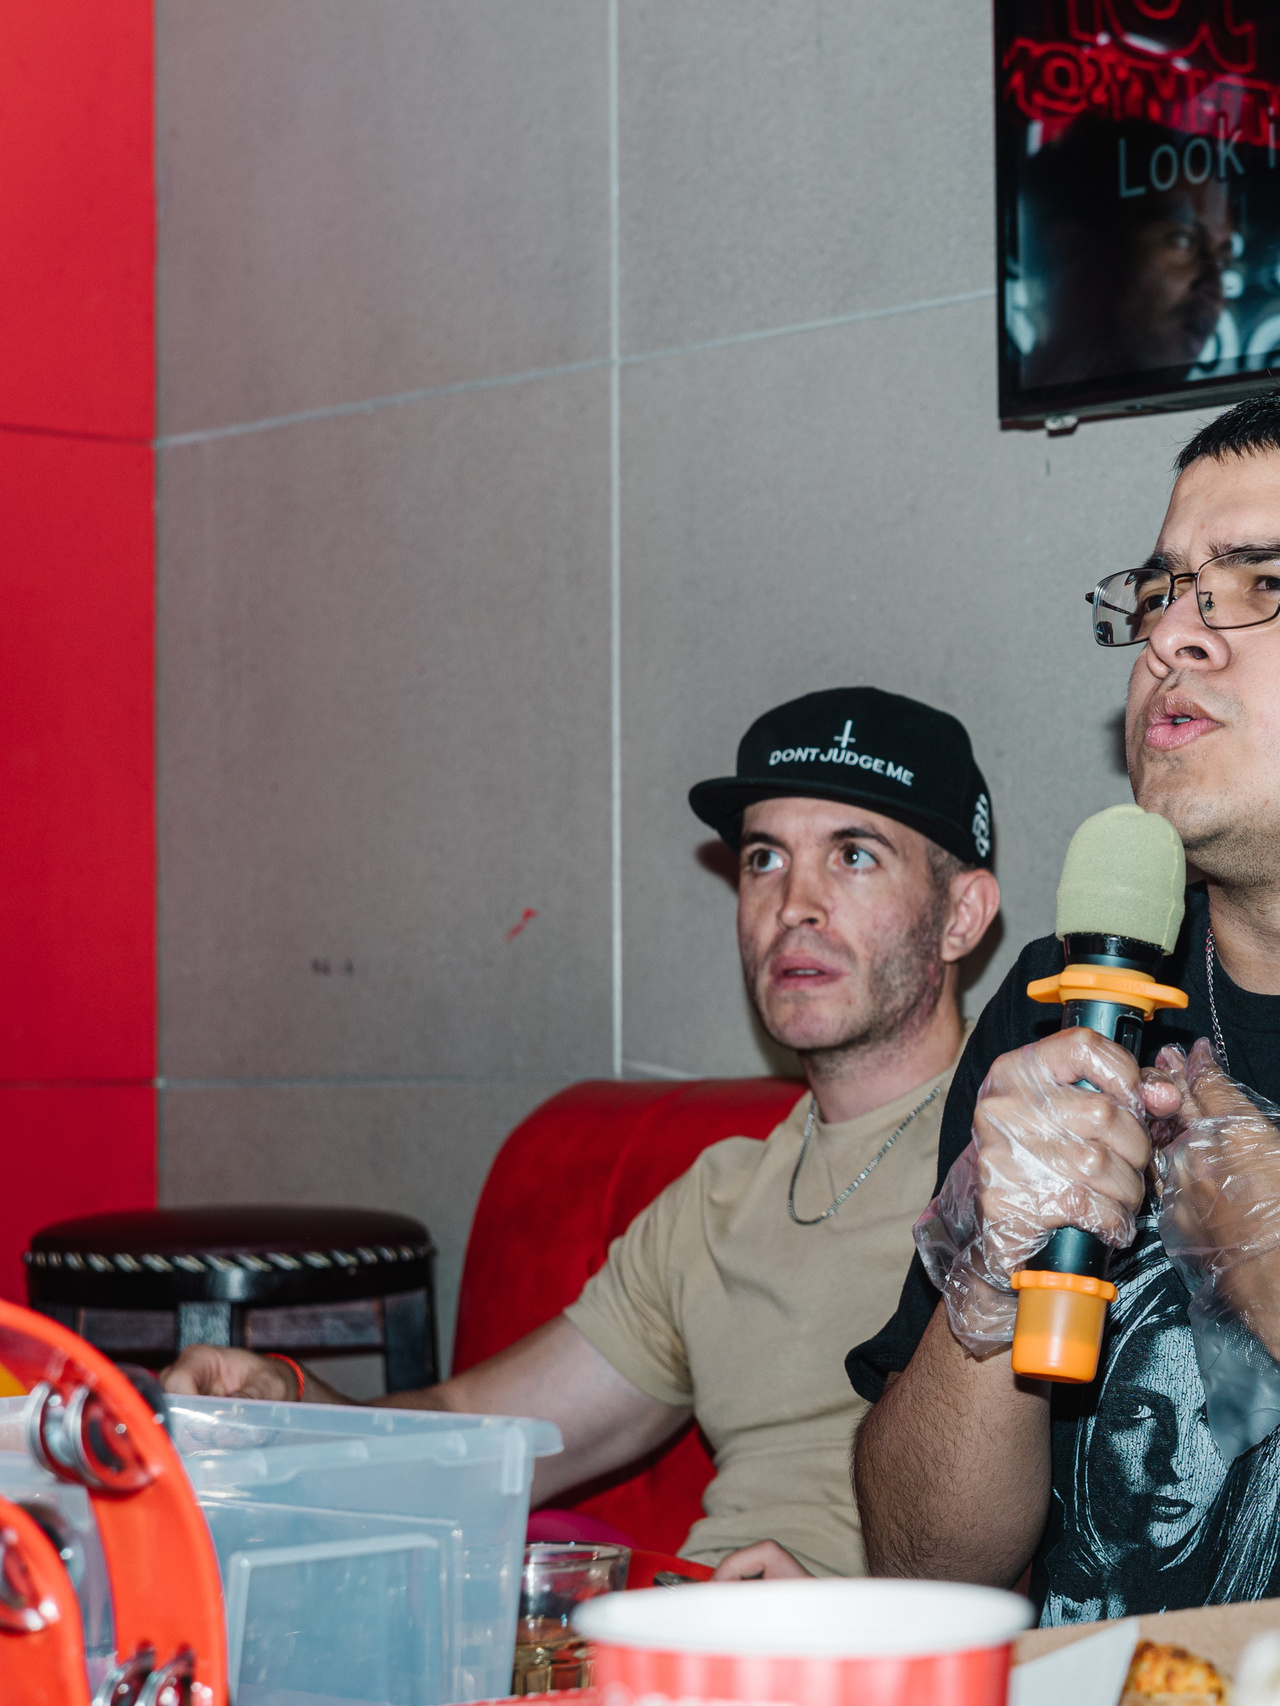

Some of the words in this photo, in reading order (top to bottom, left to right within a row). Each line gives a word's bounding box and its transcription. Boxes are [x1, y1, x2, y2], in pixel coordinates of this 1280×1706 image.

[1119, 137, 1245, 198] Look
[768, 746, 820, 766] DONT
[819, 747, 886, 775] JUDGE
[885, 760, 915, 786] ME
